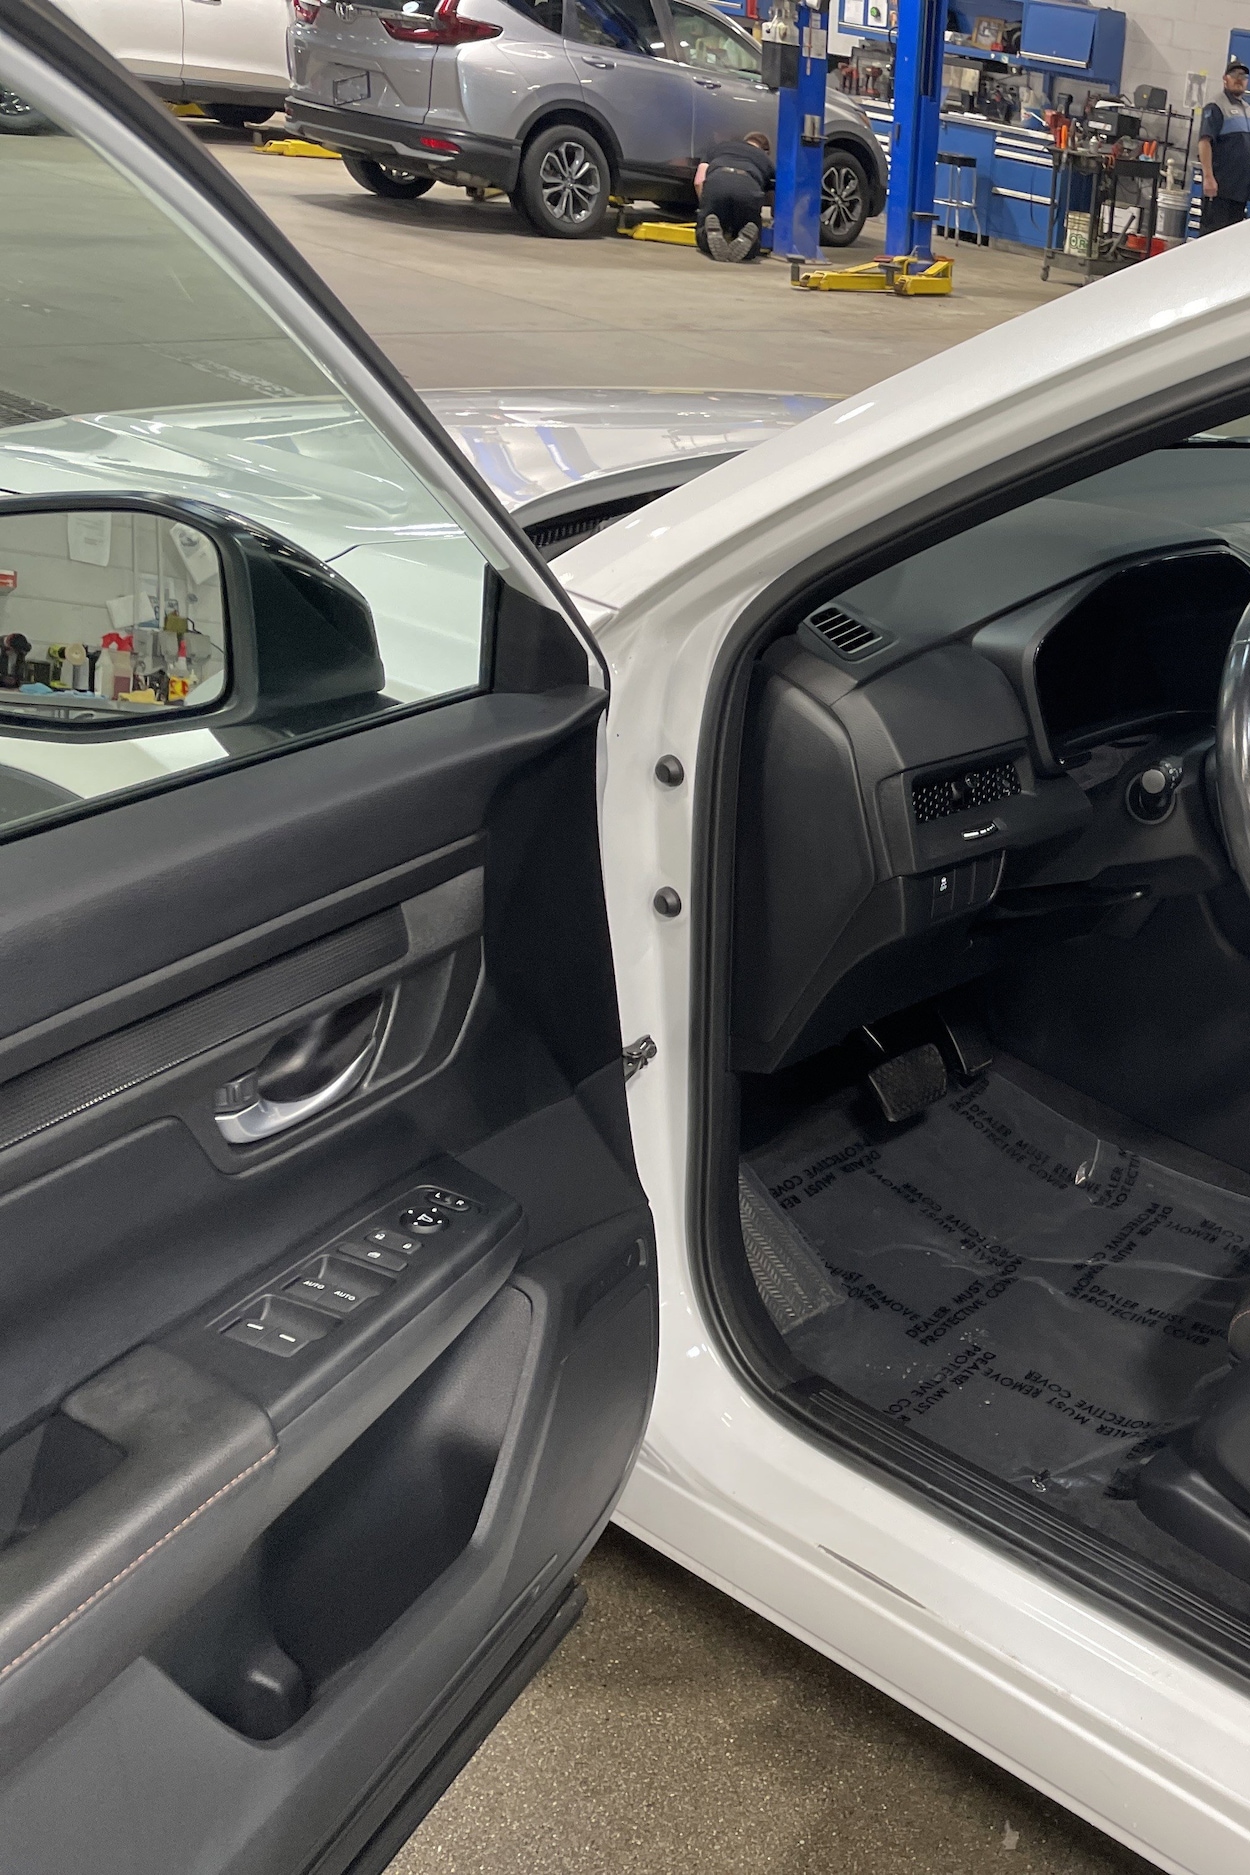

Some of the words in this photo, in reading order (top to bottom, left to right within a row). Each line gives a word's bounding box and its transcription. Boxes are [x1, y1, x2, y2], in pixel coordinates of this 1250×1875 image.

[969, 1103, 1013, 1138] DEALER
[1015, 1139, 1051, 1165] MUST
[767, 1175, 804, 1200] COVE
[803, 1171, 837, 1198] MUST
[866, 1167, 921, 1205] REMOVE
[900, 1182, 943, 1213] COVER
[919, 1208, 956, 1234] MUST
[1165, 1221, 1219, 1244] REMOVE
[1199, 1218, 1244, 1242] COVER
[1110, 1240, 1138, 1263] MUS
[302, 1280, 326, 1290] AUTO
[333, 1290, 356, 1301] AUTO
[841, 1279, 880, 1312] OVER
[861, 1283, 921, 1322] REMOVE
[1088, 1284, 1140, 1310] DEALER
[1145, 1307, 1187, 1328] MUST
[904, 1306, 952, 1339] DEALER
[952, 1279, 985, 1305] MUST
[918, 1298, 987, 1347] PROTECTIVE
[1078, 1293, 1158, 1328] PROTECTIVE
[1162, 1322, 1211, 1347] COVER
[910, 1344, 982, 1398] PROTECTIVE
[950, 1351, 997, 1386] DEALER
[983, 1367, 1043, 1399] REMOVE
[1024, 1369, 1072, 1399] COVER
[912, 1387, 950, 1415] MUST
[1046, 1396, 1090, 1426] MUST
[1074, 1399, 1153, 1430] ROTECTIVE
